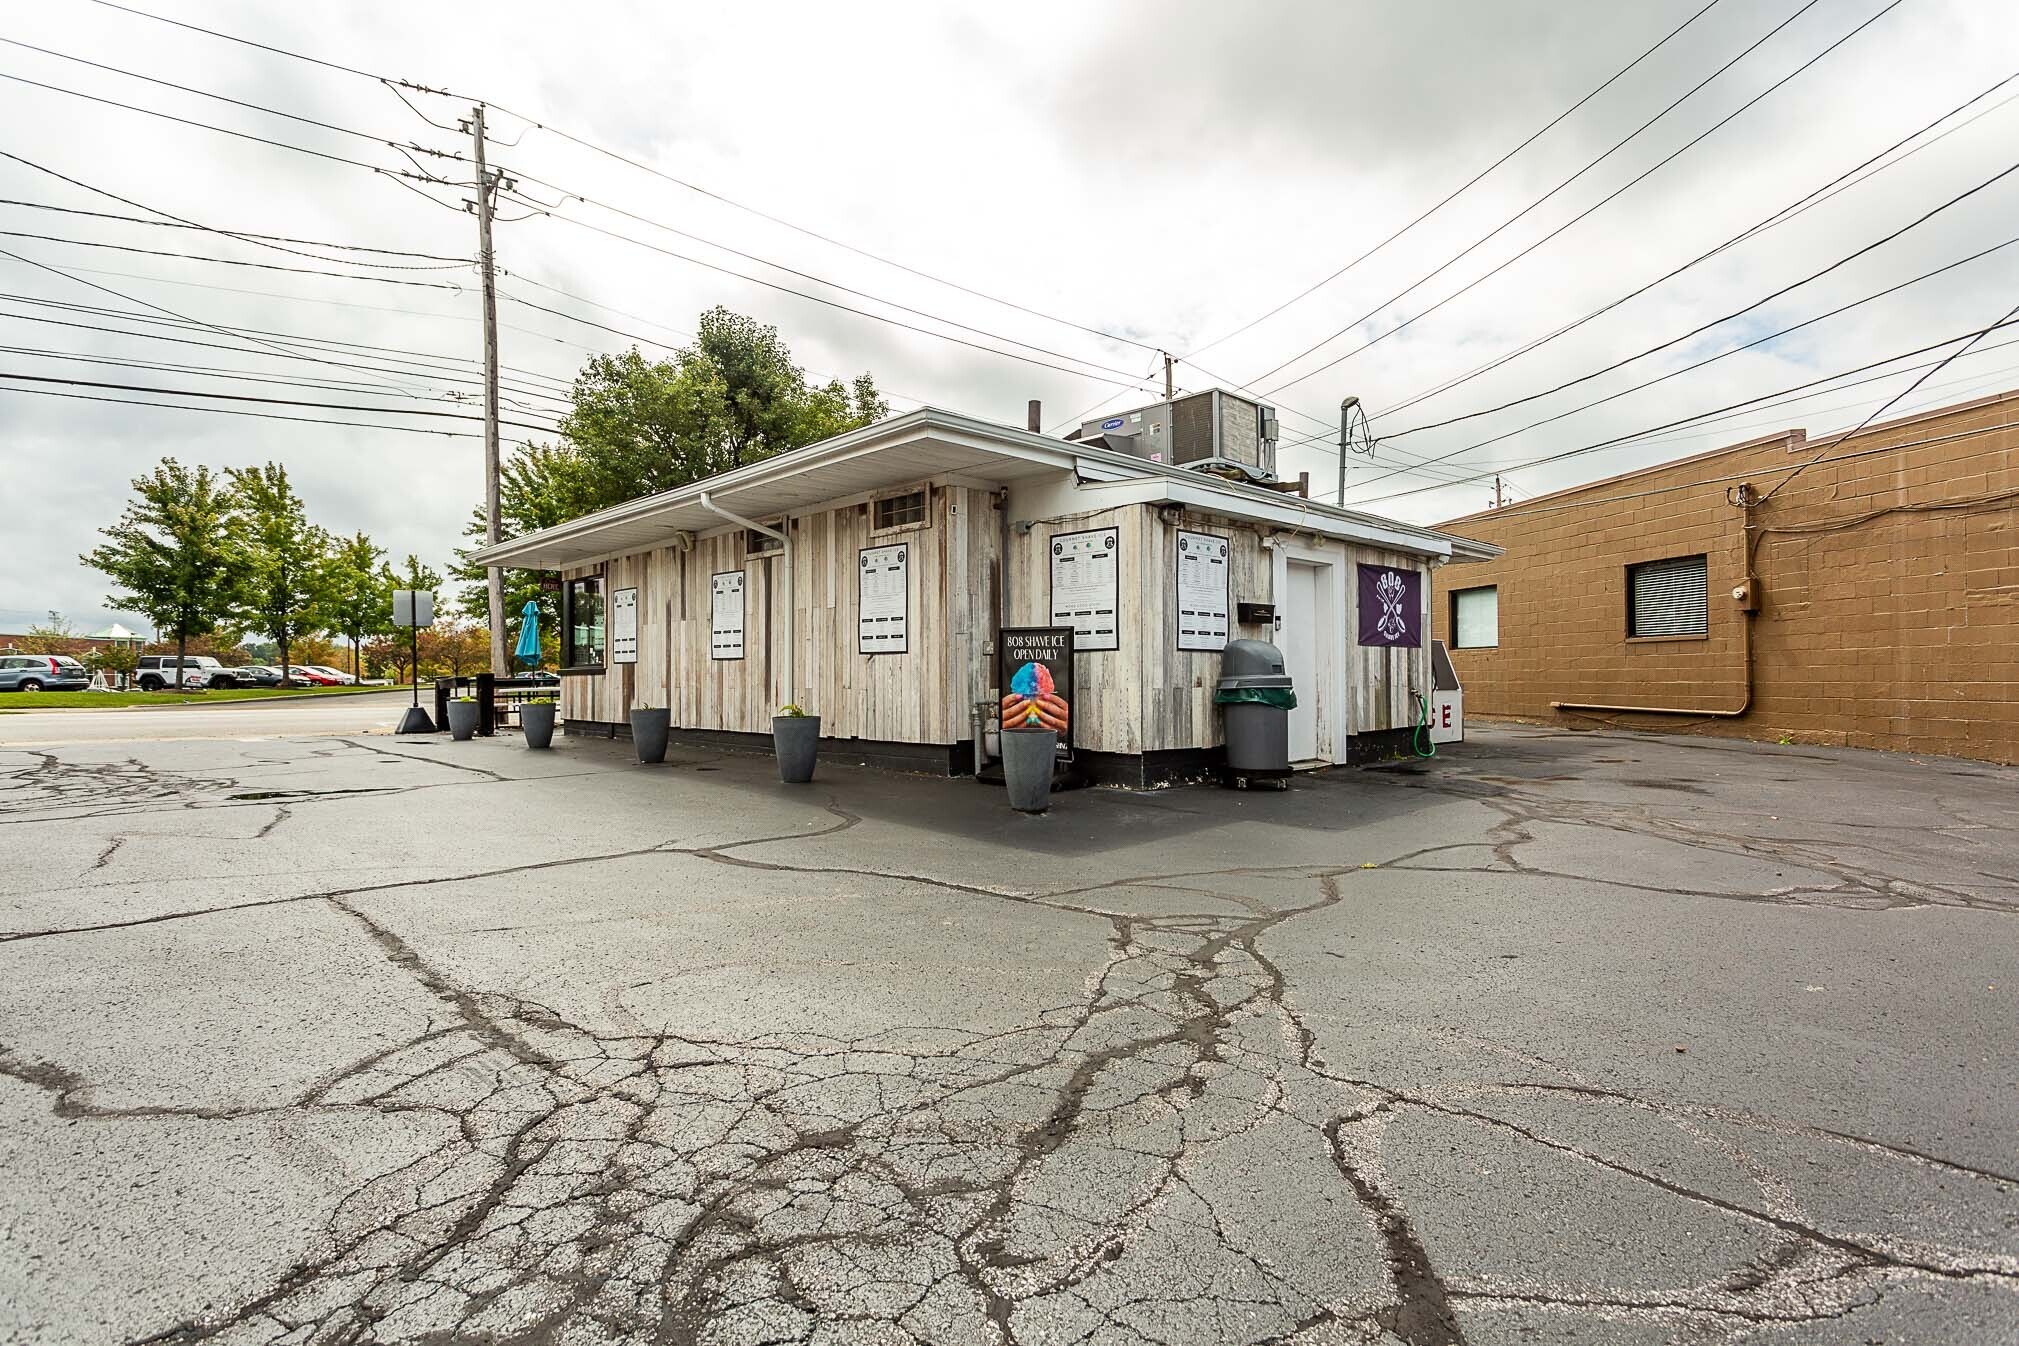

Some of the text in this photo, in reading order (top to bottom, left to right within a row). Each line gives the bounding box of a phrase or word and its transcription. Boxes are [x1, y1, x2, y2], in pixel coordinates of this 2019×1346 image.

[1007, 635, 1065, 647] 808 SHAVE ICE
[1013, 648, 1059, 660] OPEN DAILY
